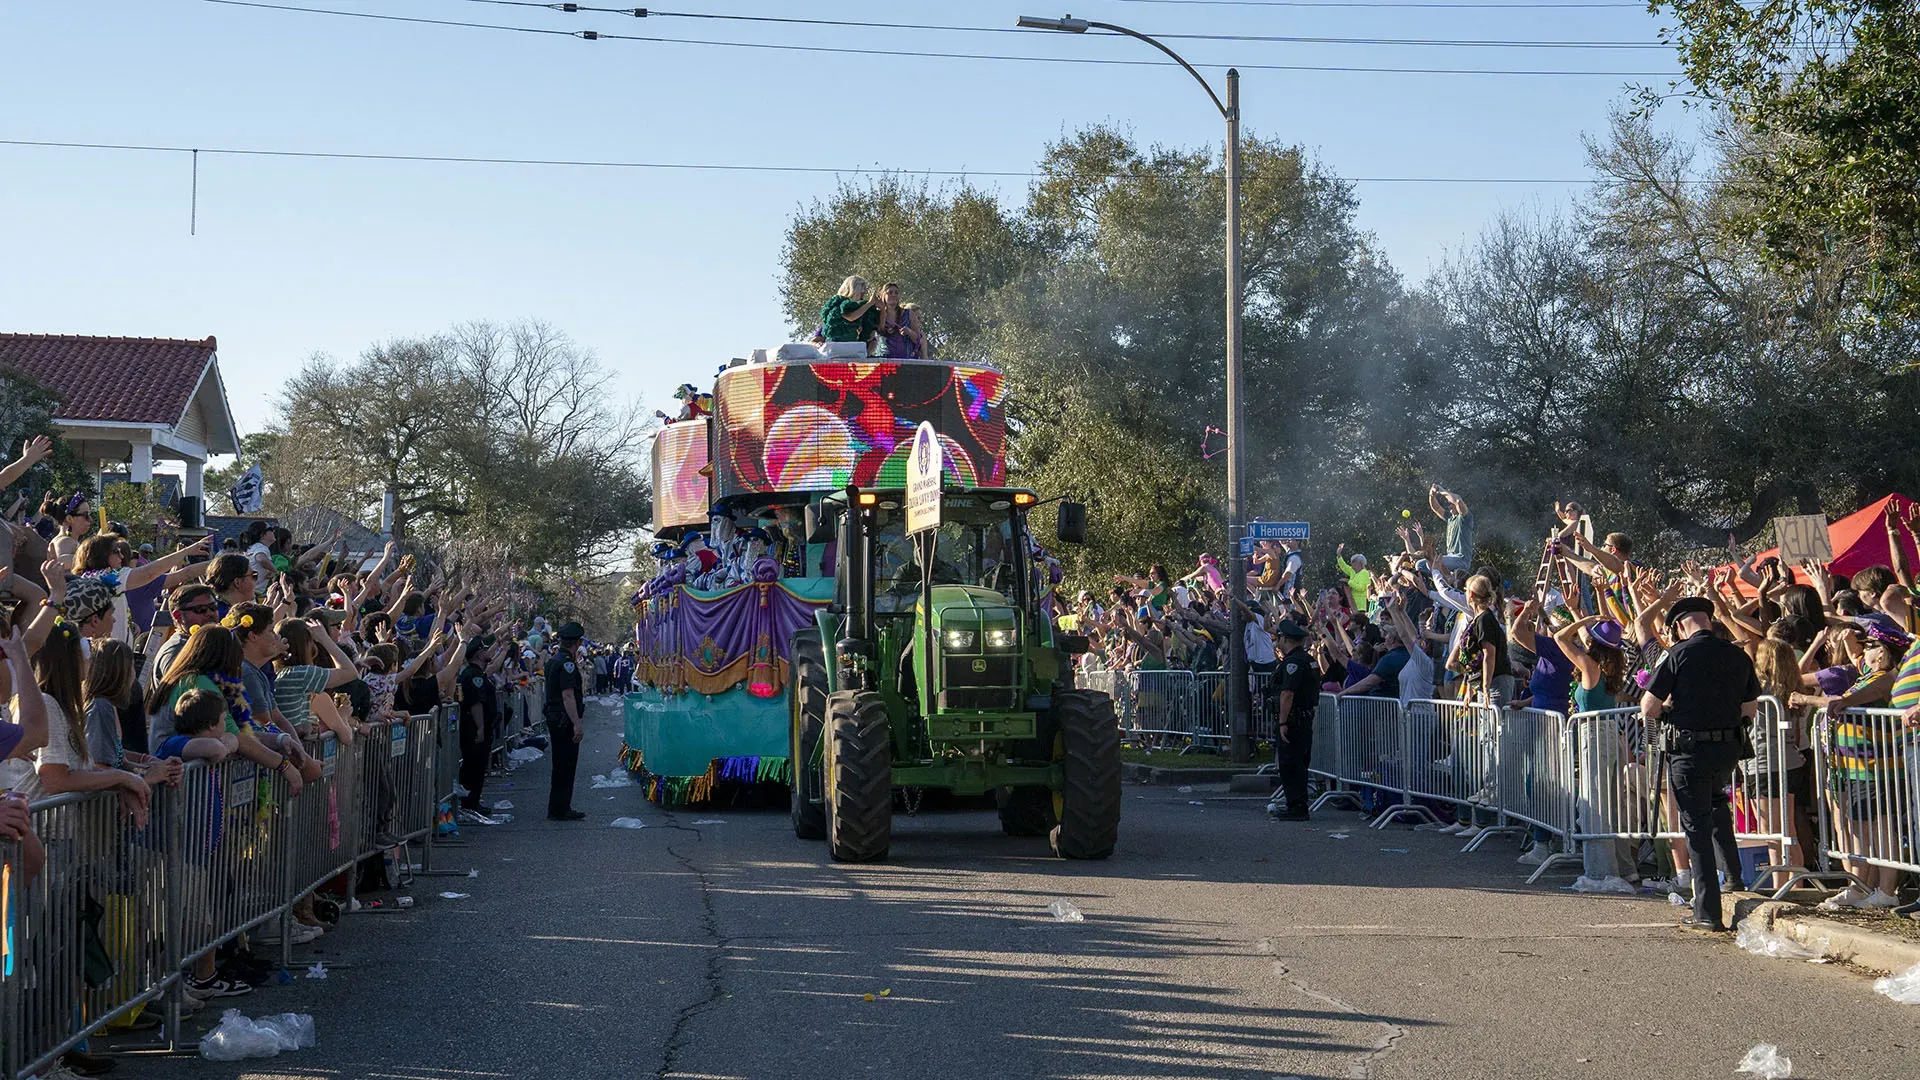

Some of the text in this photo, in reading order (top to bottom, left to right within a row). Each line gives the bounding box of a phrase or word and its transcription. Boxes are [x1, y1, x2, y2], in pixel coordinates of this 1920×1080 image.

[944, 499, 973, 507] HINE
[1249, 525, 1307, 539] N Hennessey
